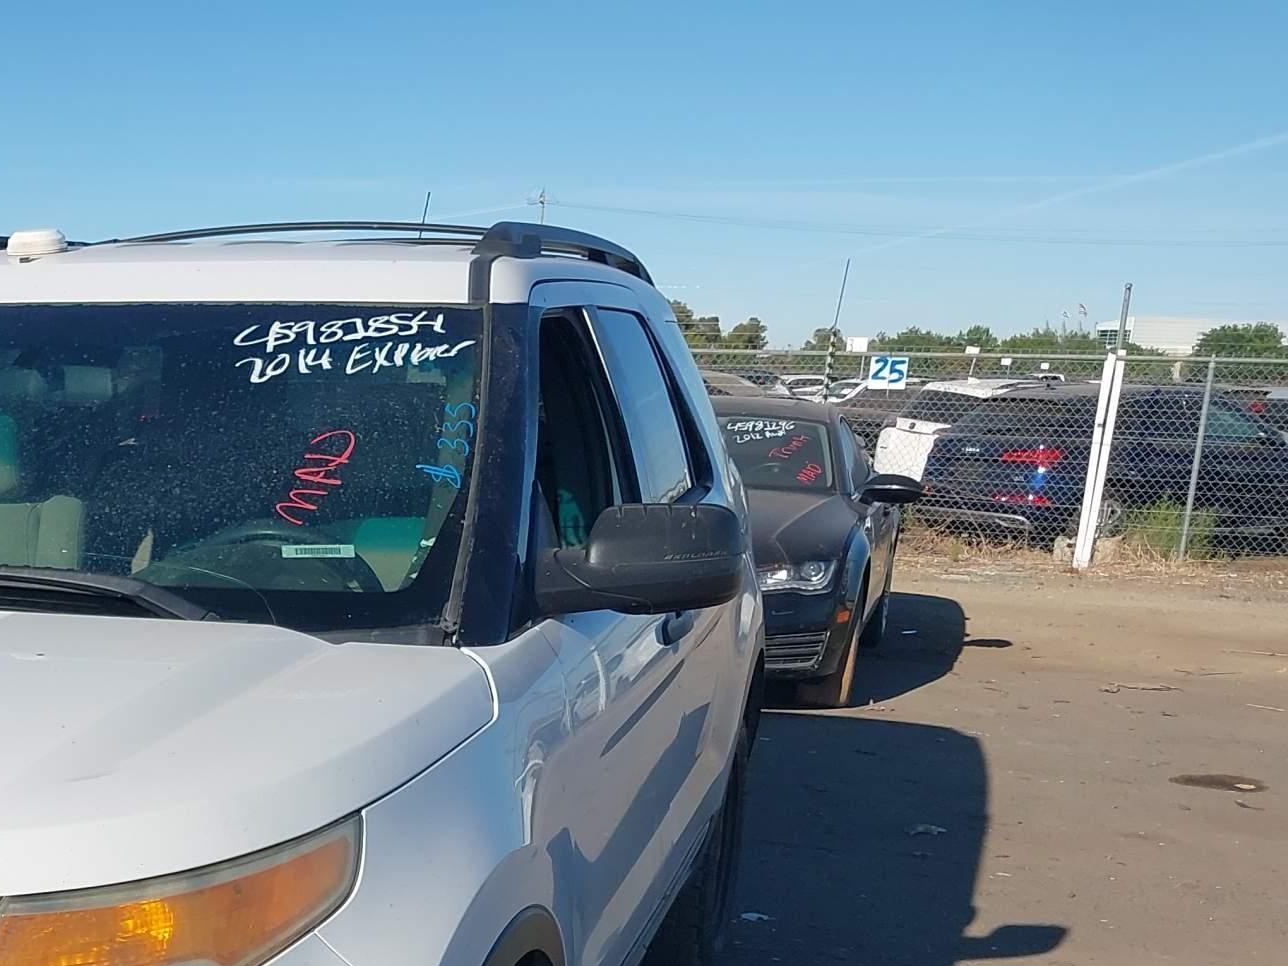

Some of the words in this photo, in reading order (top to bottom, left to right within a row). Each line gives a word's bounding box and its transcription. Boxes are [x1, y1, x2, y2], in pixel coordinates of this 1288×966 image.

[235, 348, 333, 383] 2014
[871, 356, 907, 384] 25
[733, 432, 764, 443] 2012
